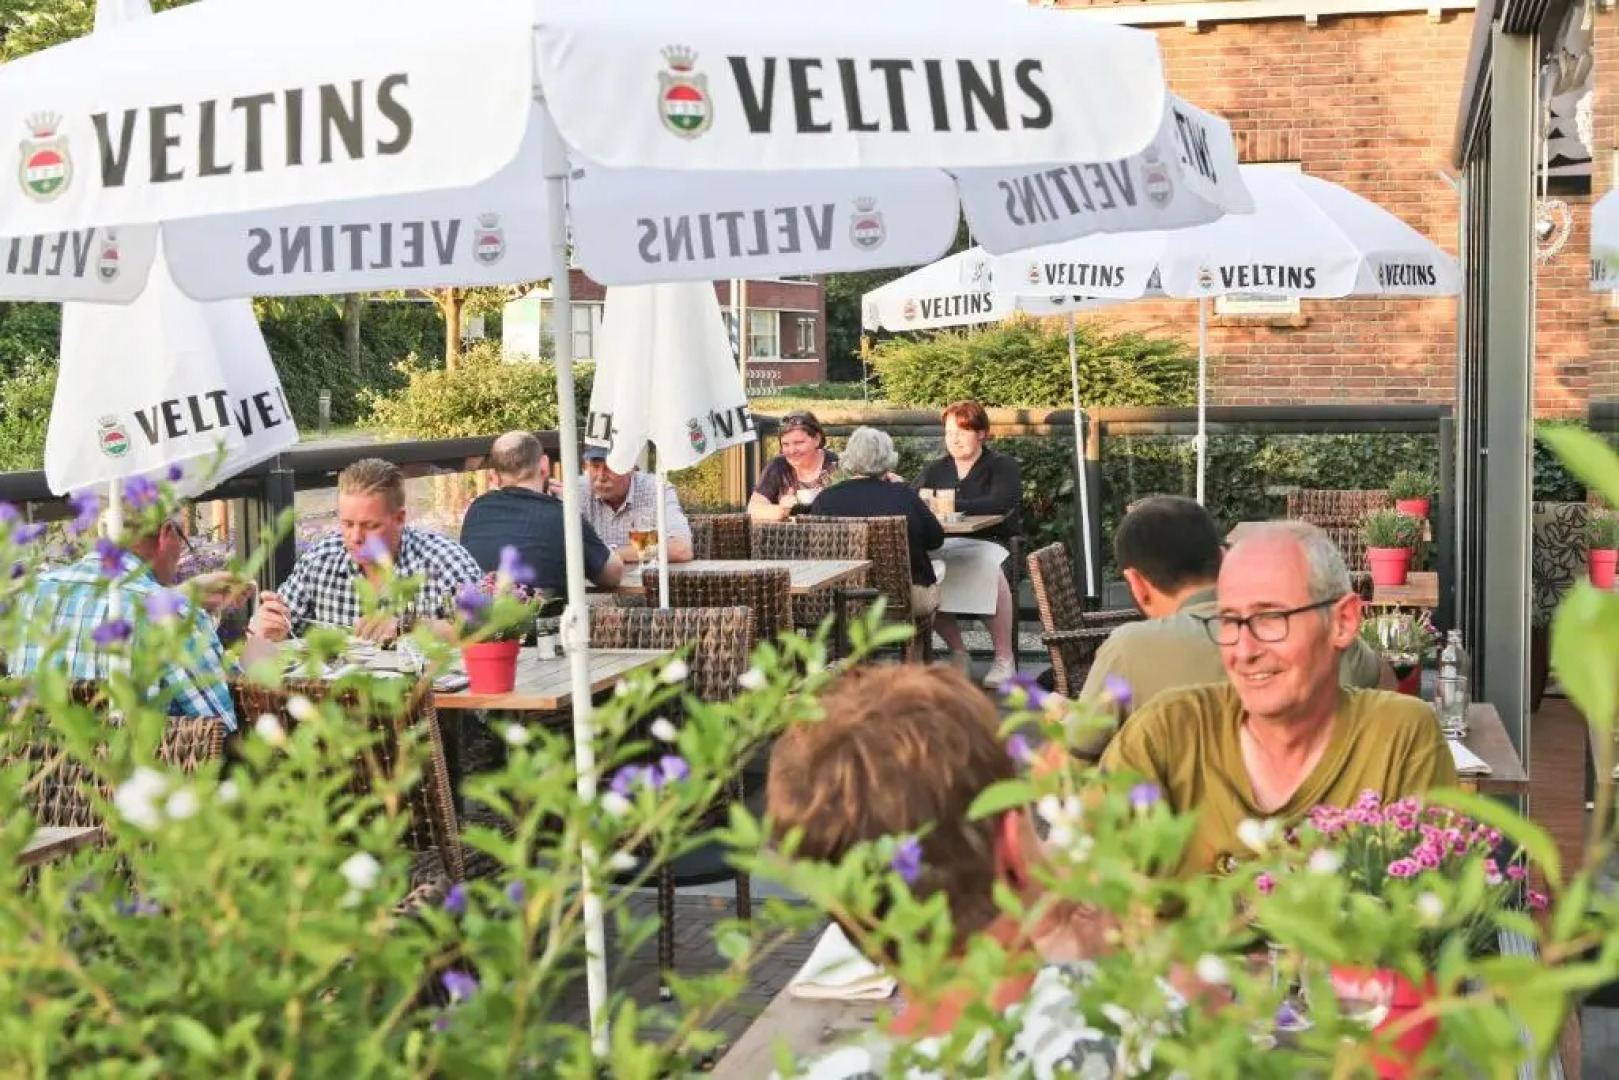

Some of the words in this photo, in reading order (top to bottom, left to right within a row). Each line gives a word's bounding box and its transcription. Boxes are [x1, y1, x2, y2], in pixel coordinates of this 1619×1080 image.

[727, 56, 1053, 133] VELTINS
[91, 73, 412, 187] VELTINS
[1045, 263, 1124, 286] VELTINS
[1220, 265, 1316, 288] VELTINS
[1385, 263, 1436, 286] VELTINS
[920, 292, 992, 318] VELTINS
[134, 390, 230, 445] VELT
